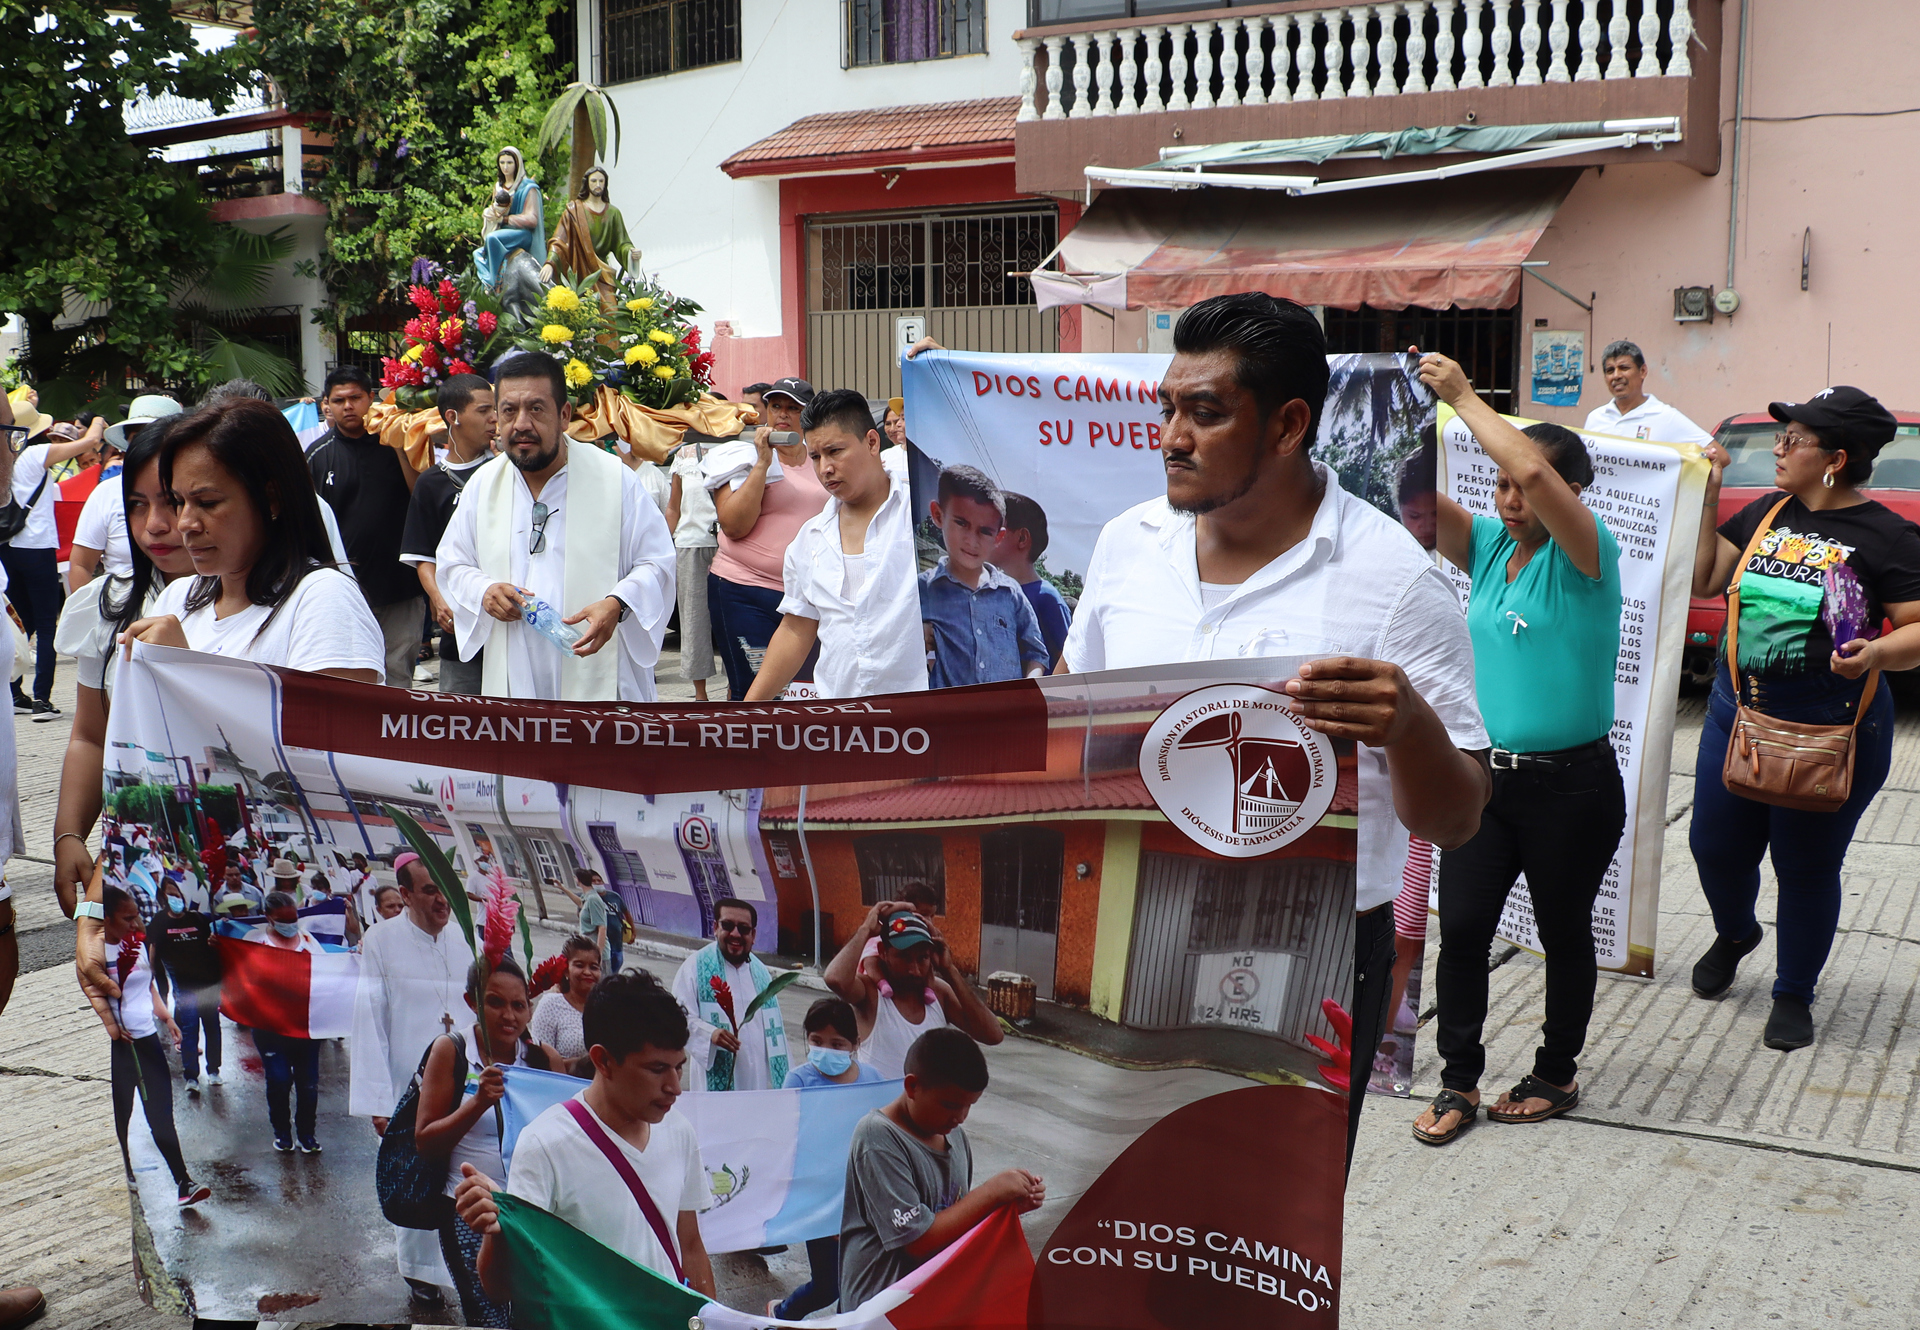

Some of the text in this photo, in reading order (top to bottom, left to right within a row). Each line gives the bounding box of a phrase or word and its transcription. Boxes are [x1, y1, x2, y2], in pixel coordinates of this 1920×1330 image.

[972, 371, 1041, 398] DIOS
[1039, 419, 1073, 446] SU
[1454, 430, 1466, 442] TÚ
[1454, 444, 1468, 453] TU
[1596, 454, 1666, 472] PROCLAMAR
[1457, 484, 1480, 497] CASA
[1482, 490, 1489, 498] Y
[1471, 464, 1484, 474] TE
[1606, 488, 1661, 508] AQUELLAS
[1456, 497, 1462, 506] A
[1468, 498, 1488, 511] UNA
[1618, 504, 1659, 524] PATRIA,
[1630, 548, 1654, 562] COM
[1450, 566, 1462, 576] DE
[1624, 610, 1644, 623] SUS
[1620, 624, 1643, 636] LOS
[1618, 649, 1641, 660] DOS
[381, 714, 930, 754] MIGRANTE Y DEL REFUGIADO
[1158, 700, 1324, 789] DIMENSIÓN PASTORAL DE MOVILIDAD HUMANA
[690, 824, 703, 844] E
[1180, 807, 1306, 846] DIÓCESIS DE TAPACHULA
[1602, 907, 1616, 917] DE
[1232, 956, 1254, 967] NO
[1206, 1006, 1264, 1024] 24 HRS.
[1097, 1219, 1334, 1291] “DIOS CAMINA
[1048, 1246, 1332, 1312] CON SU PUEBLO”
